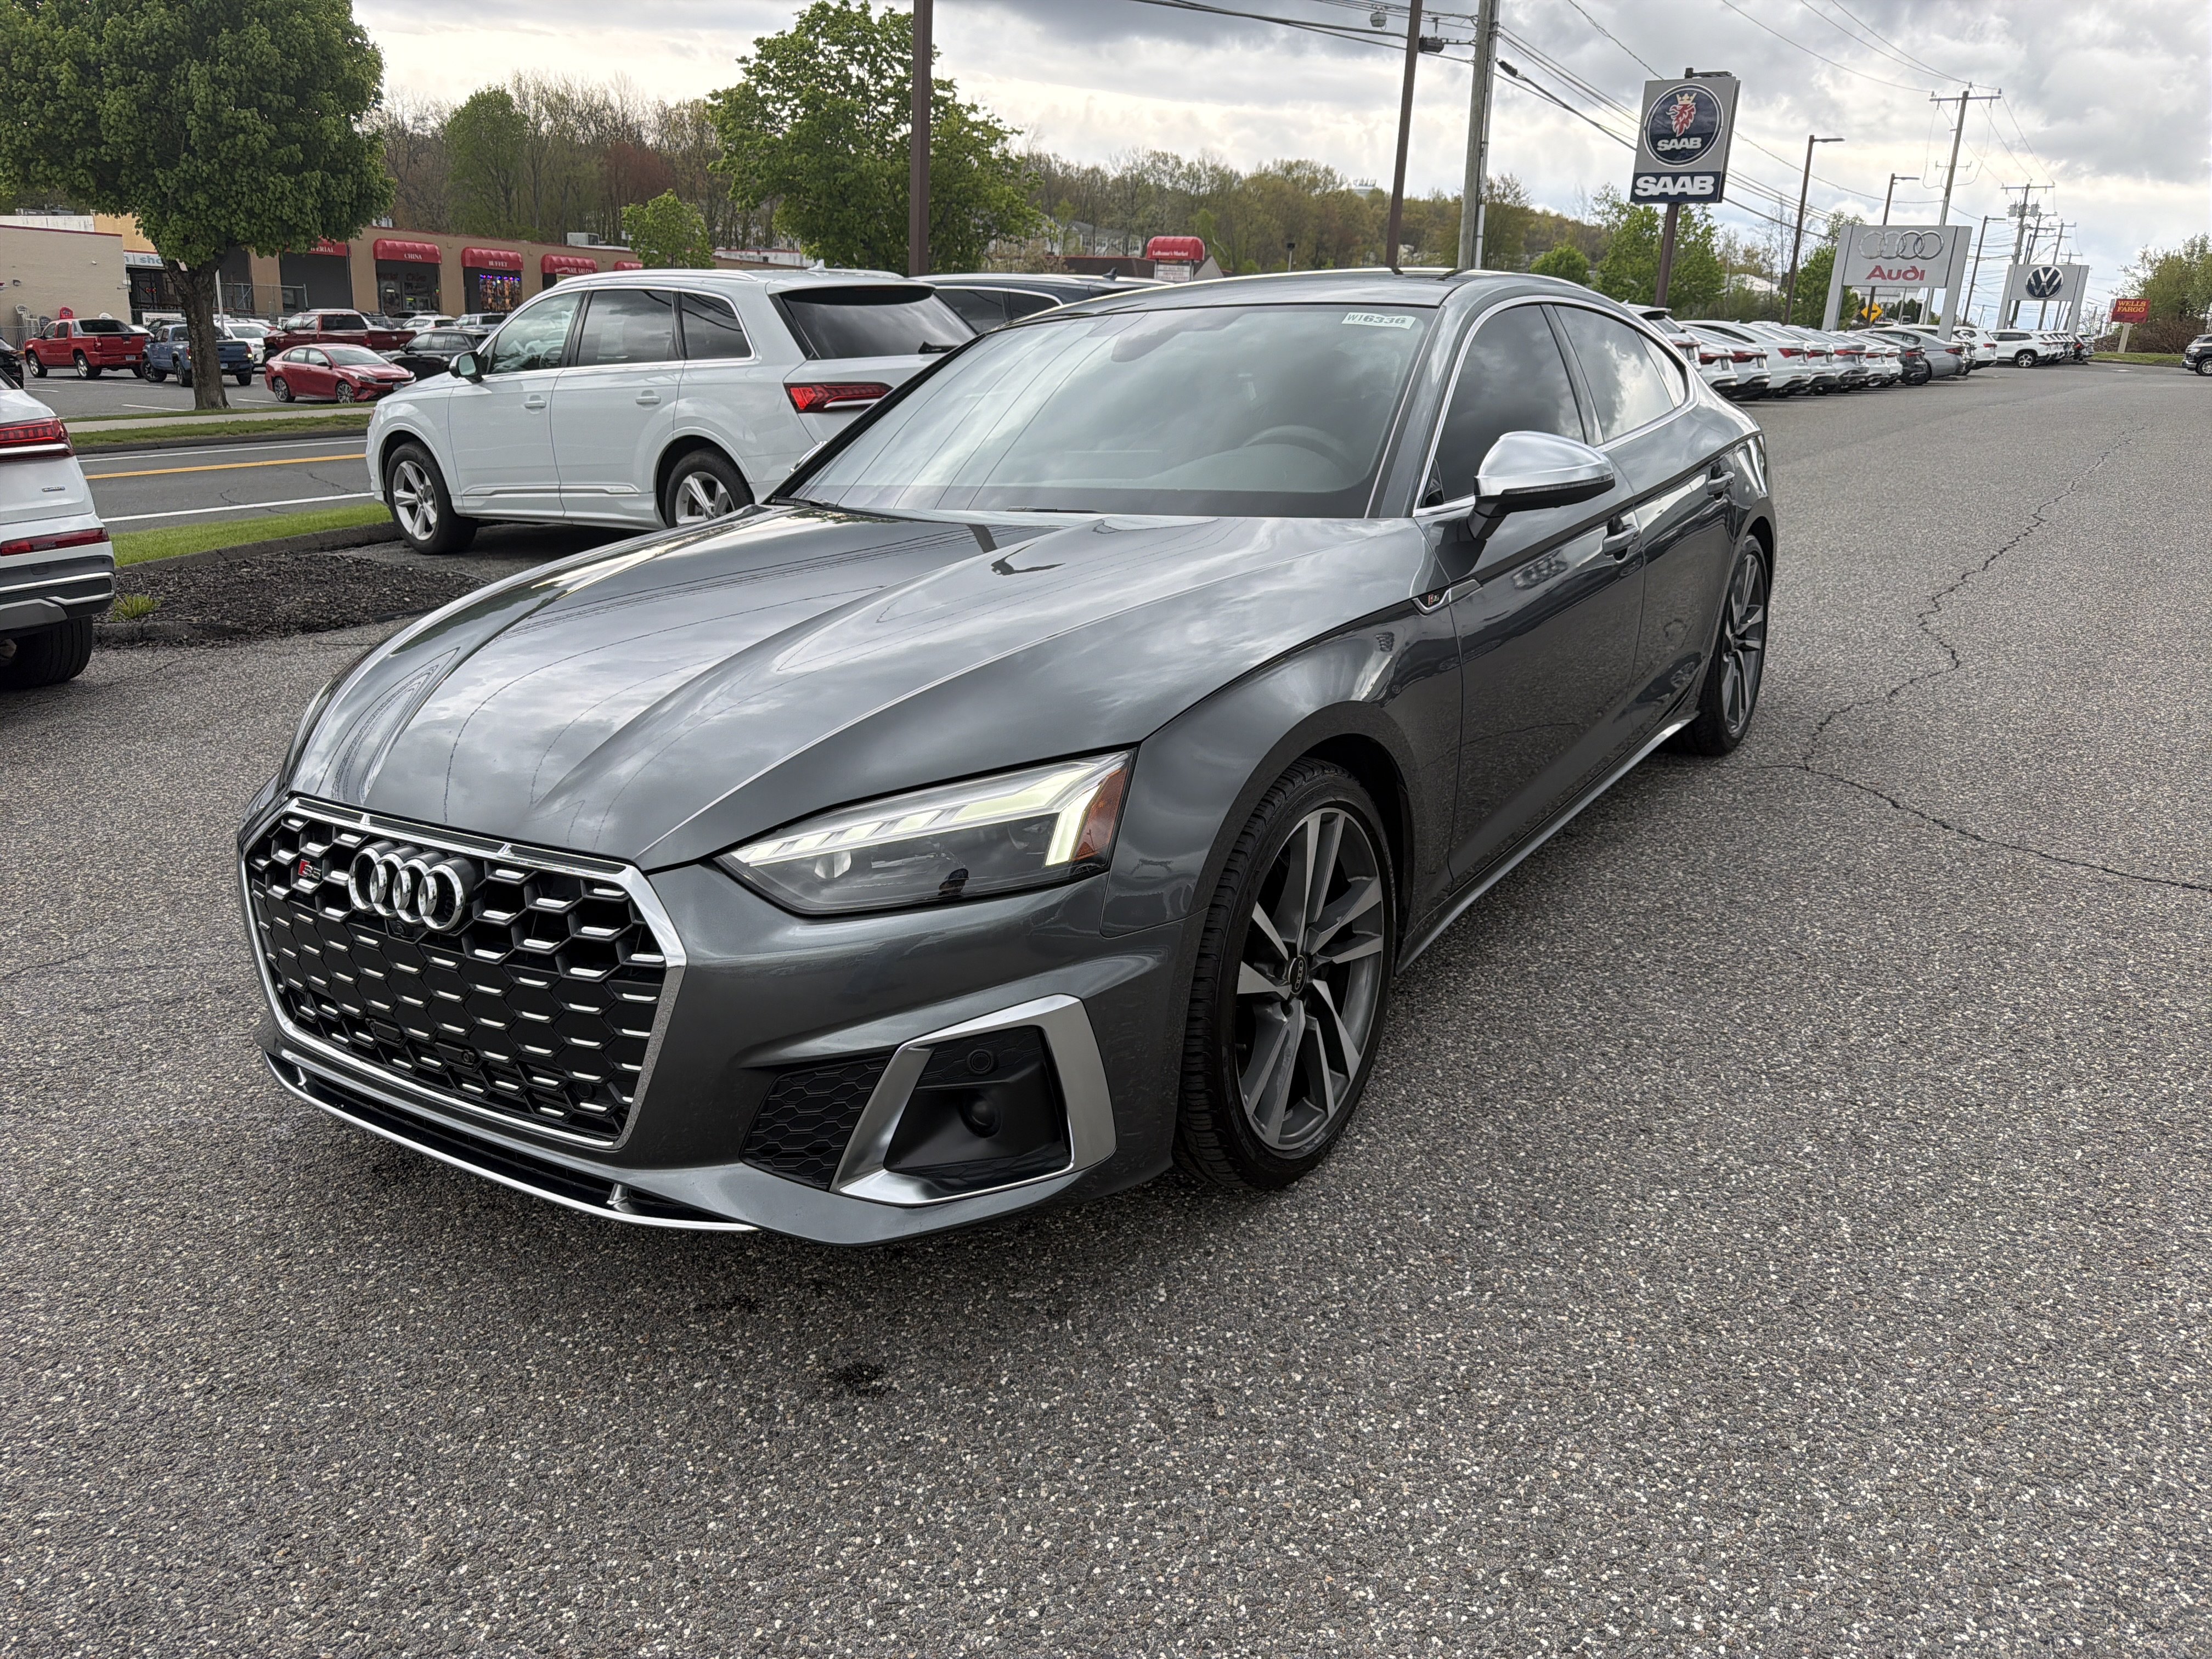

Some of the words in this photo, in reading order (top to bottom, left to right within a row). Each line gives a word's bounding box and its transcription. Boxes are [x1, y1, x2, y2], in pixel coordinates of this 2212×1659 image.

[1657, 138, 1702, 151] SAAB
[1634, 176, 1714, 196] SAAB
[1865, 265, 1926, 281] Audi
[1347, 314, 1407, 324] W16336
